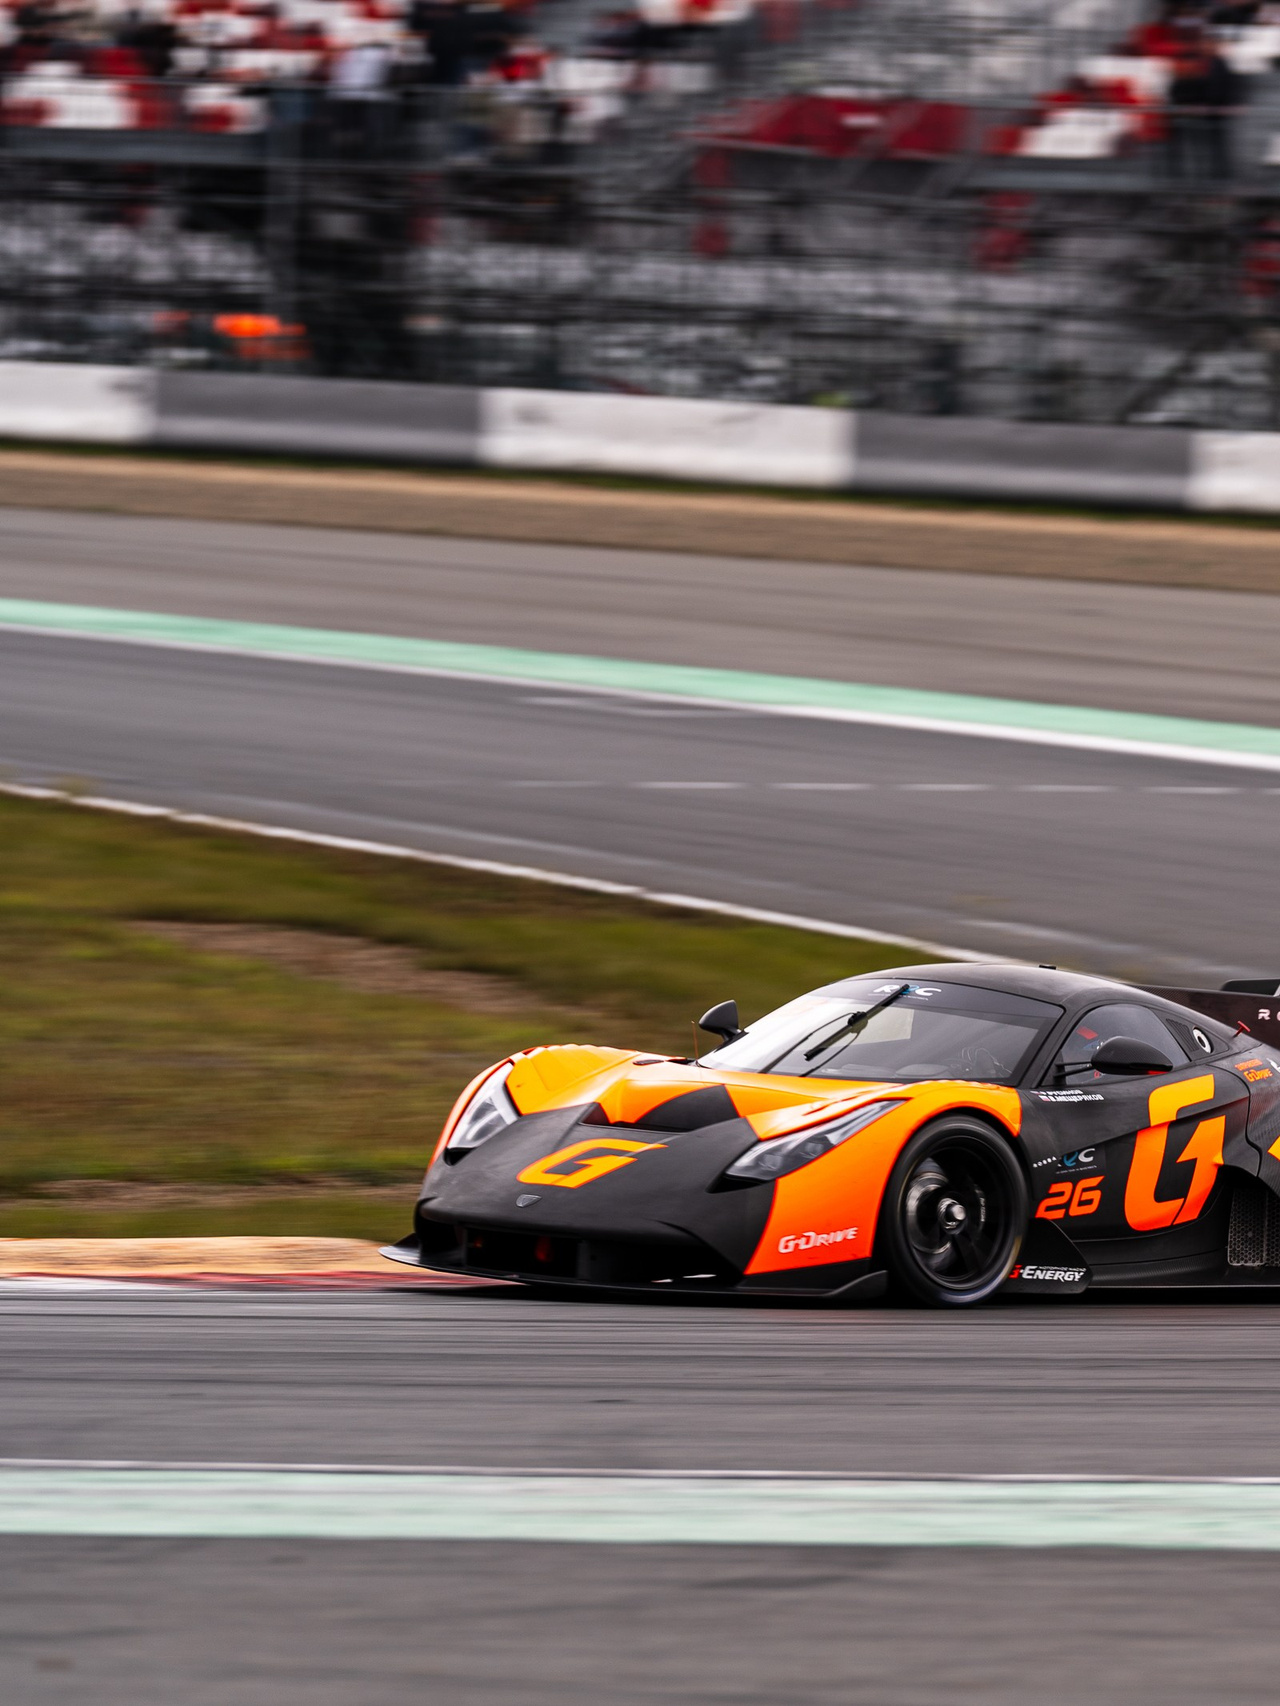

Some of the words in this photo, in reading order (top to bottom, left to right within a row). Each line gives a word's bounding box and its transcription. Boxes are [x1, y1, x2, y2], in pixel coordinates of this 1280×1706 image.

[515, 1137, 670, 1189] G
[1124, 1073, 1226, 1232] G
[1035, 1175, 1106, 1221] 26
[778, 1226, 859, 1254] G-DRIVE
